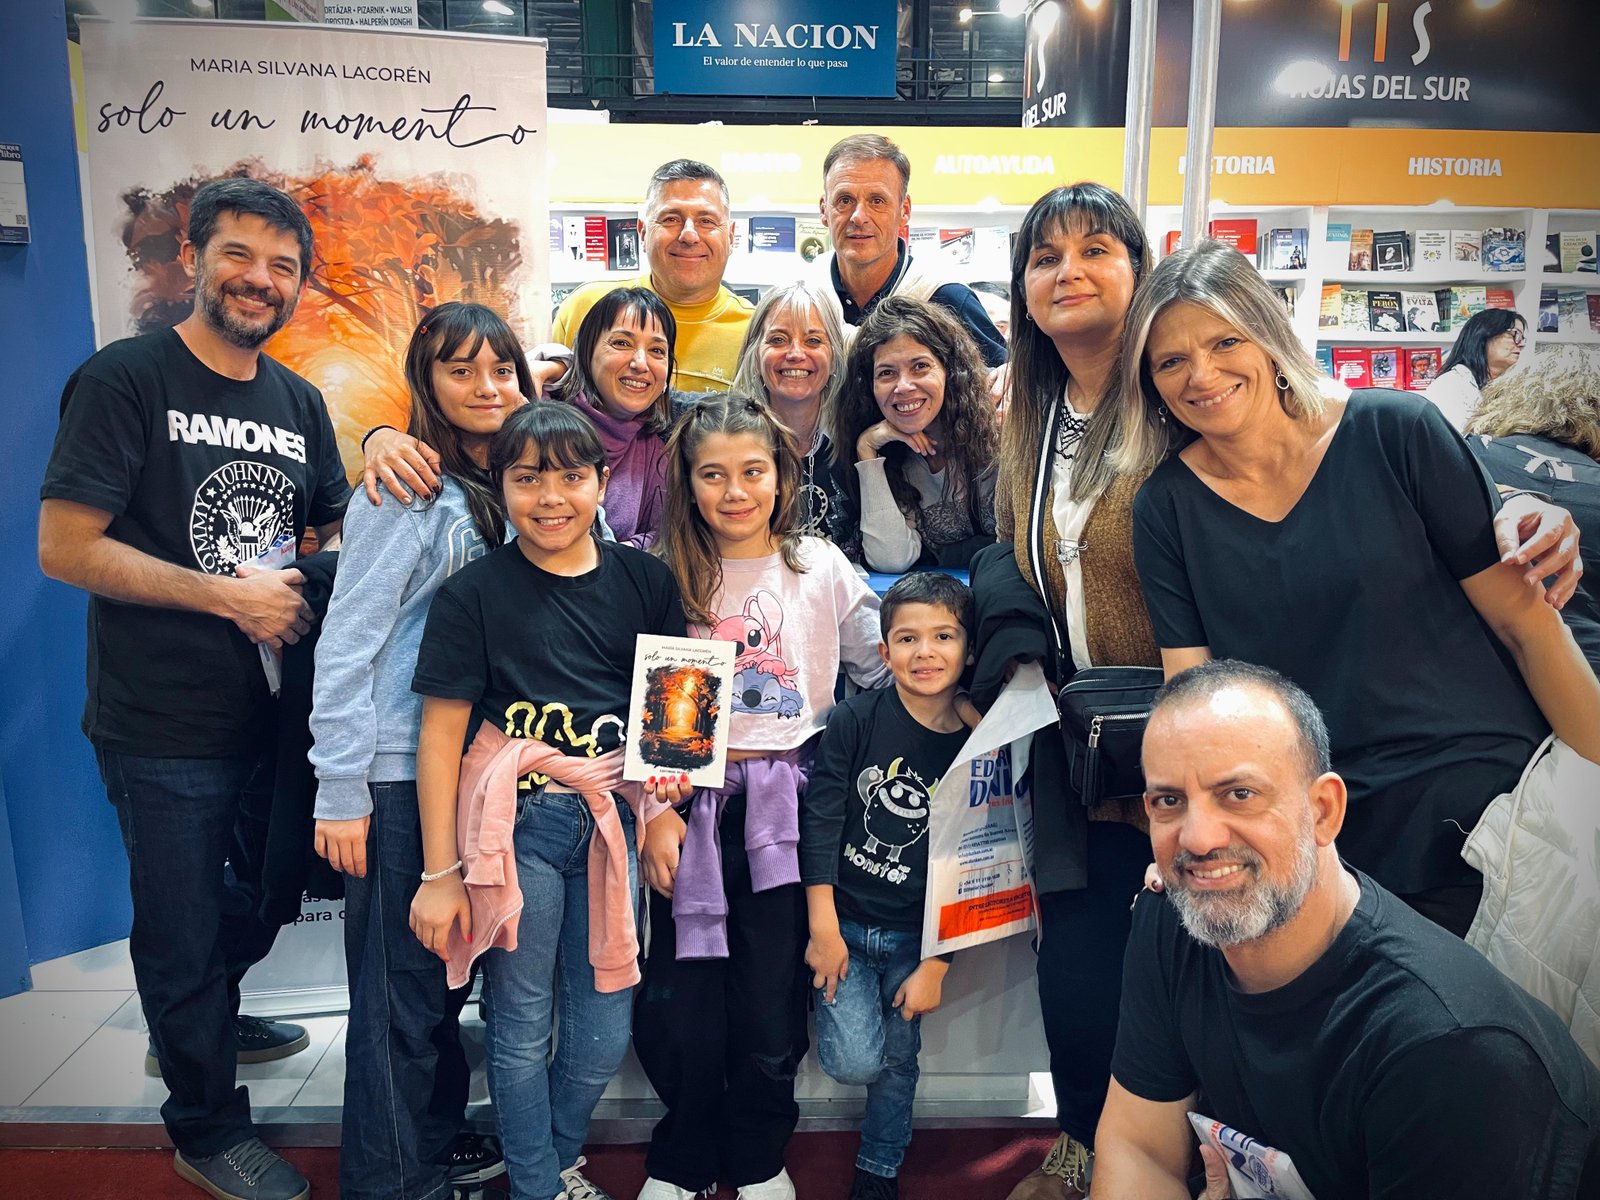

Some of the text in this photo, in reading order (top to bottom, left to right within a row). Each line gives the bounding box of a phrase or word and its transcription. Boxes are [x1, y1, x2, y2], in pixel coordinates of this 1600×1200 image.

[357, 6, 385, 14] PIZARNIK
[390, 6, 412, 14] WALSH
[359, 16, 388, 26] HALPERÍN
[390, 18, 412, 26] DONGHI
[672, 22, 879, 50] LA NACION
[190, 57, 432, 84] MARIA SILVANA LACORÉN
[703, 56, 849, 69] El valor de entender lo que pasa
[1290, 74, 1470, 101] OJAS DEL SUR
[98, 80, 537, 149] solo un momento
[1041, 92, 1067, 122] SUR
[933, 154, 1056, 175] AUTOAYUDA
[1178, 155, 1276, 175] TORIA
[1408, 157, 1503, 177] HISTORIA
[167, 409, 307, 464] RAMONES
[213, 463, 292, 495] JOHNNY
[294, 910, 332, 926] para
